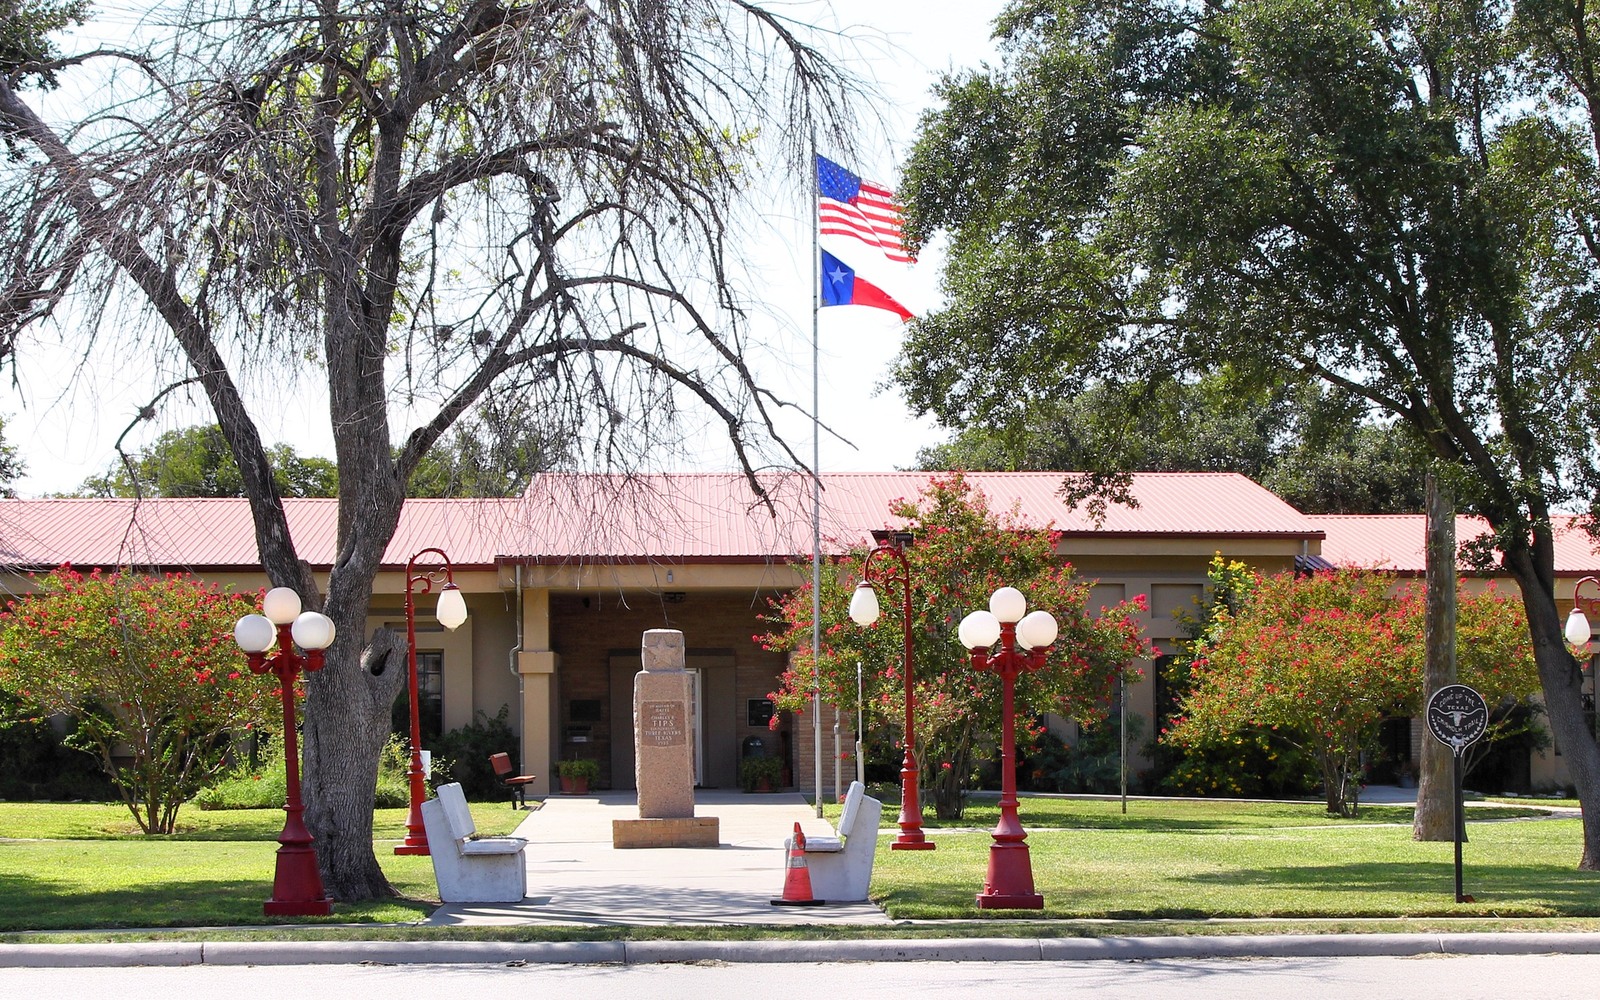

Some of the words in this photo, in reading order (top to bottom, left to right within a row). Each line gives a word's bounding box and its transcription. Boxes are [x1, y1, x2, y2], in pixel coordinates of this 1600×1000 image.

[1464, 695, 1475, 708] THE
[1437, 716, 1462, 733] CHISHOLM
[1464, 718, 1479, 730] TRAIL
